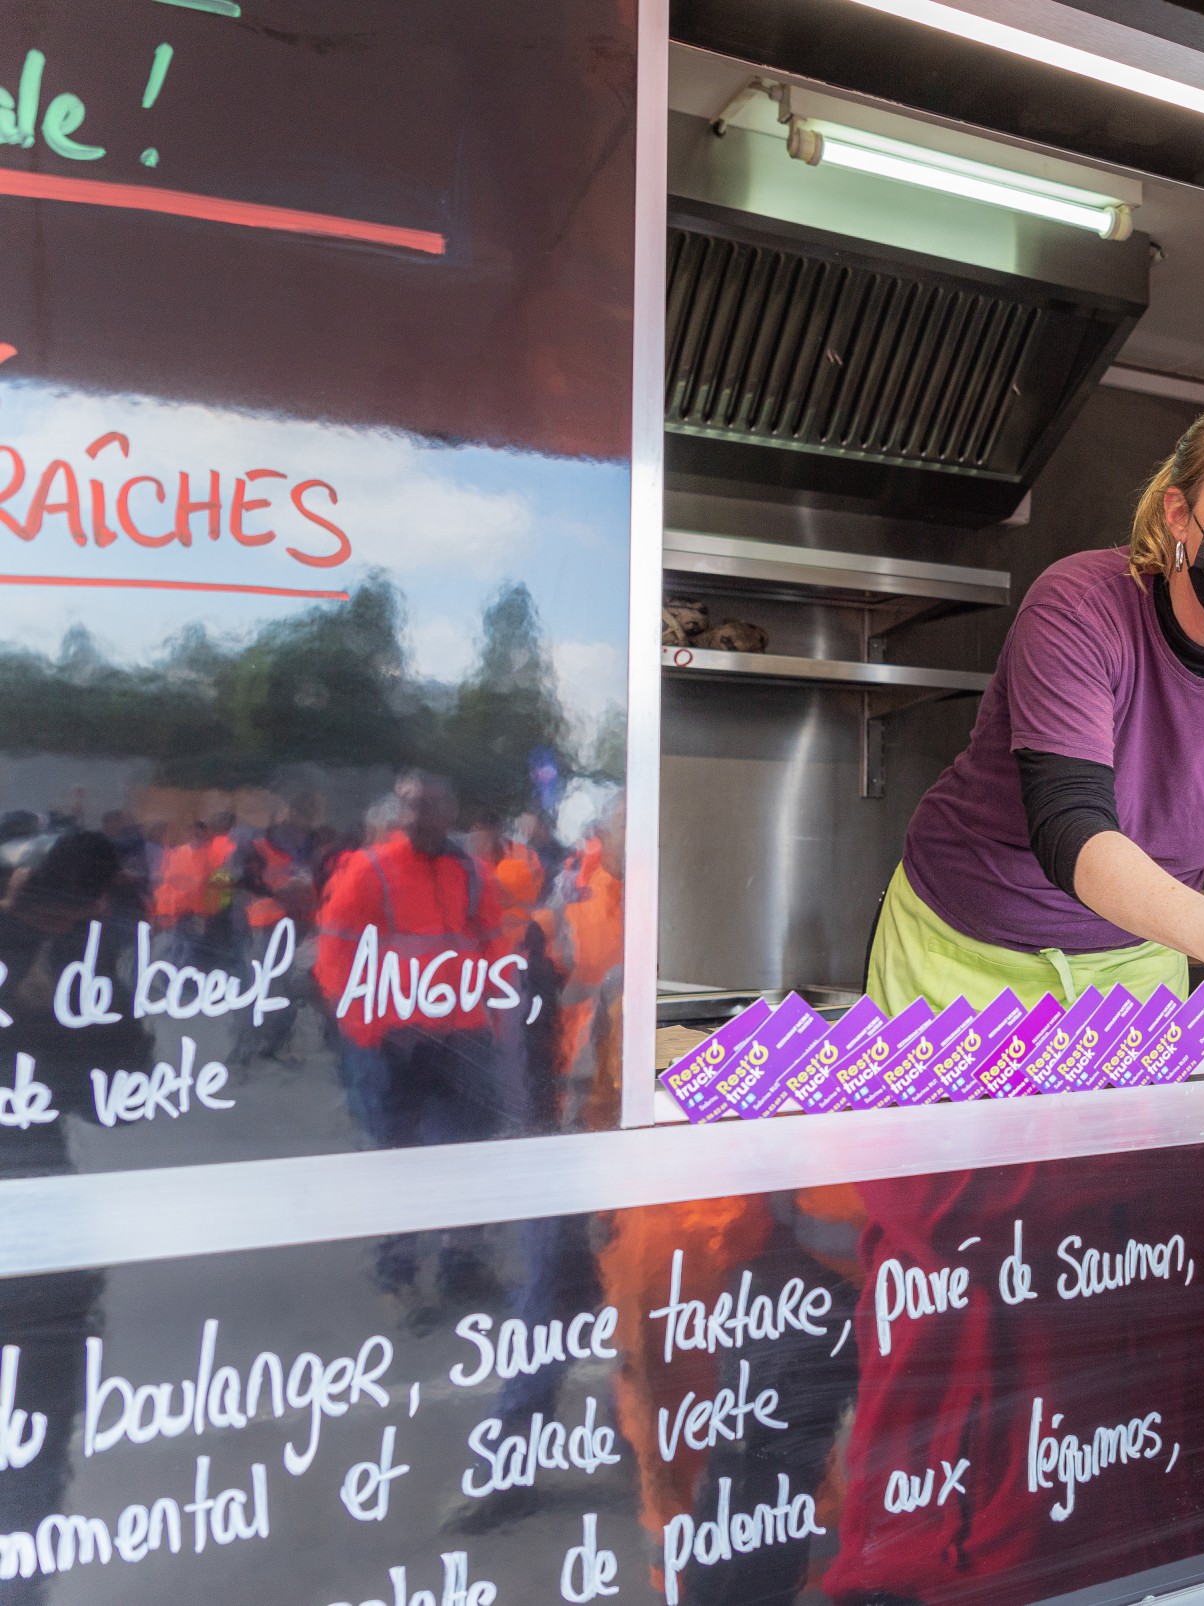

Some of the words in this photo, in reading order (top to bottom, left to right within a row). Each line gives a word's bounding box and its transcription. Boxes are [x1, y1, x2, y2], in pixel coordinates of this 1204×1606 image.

[54, 921, 122, 1027] de
[337, 924, 542, 1024] ANGUS,
[890, 1060, 927, 1094] truck
[940, 1052, 976, 1087] truck
[1065, 1048, 1096, 1083] truck
[1109, 1047, 1140, 1081] truck
[1147, 1043, 1178, 1075] truck
[91, 1036, 235, 1126] verte
[675, 1065, 718, 1101] truck
[726, 1066, 766, 1105] truck
[795, 1065, 831, 1101] truck
[843, 1061, 882, 1094] truck
[84, 1319, 420, 1476] boulanger,
[999, 1220, 1037, 1304] de
[340, 1426, 410, 1521] et
[659, 1360, 788, 1461] verte
[561, 1513, 619, 1603] de
[663, 1474, 826, 1606] polenta
[885, 1459, 970, 1513] aux
[1028, 1398, 1179, 1521] légumes,
